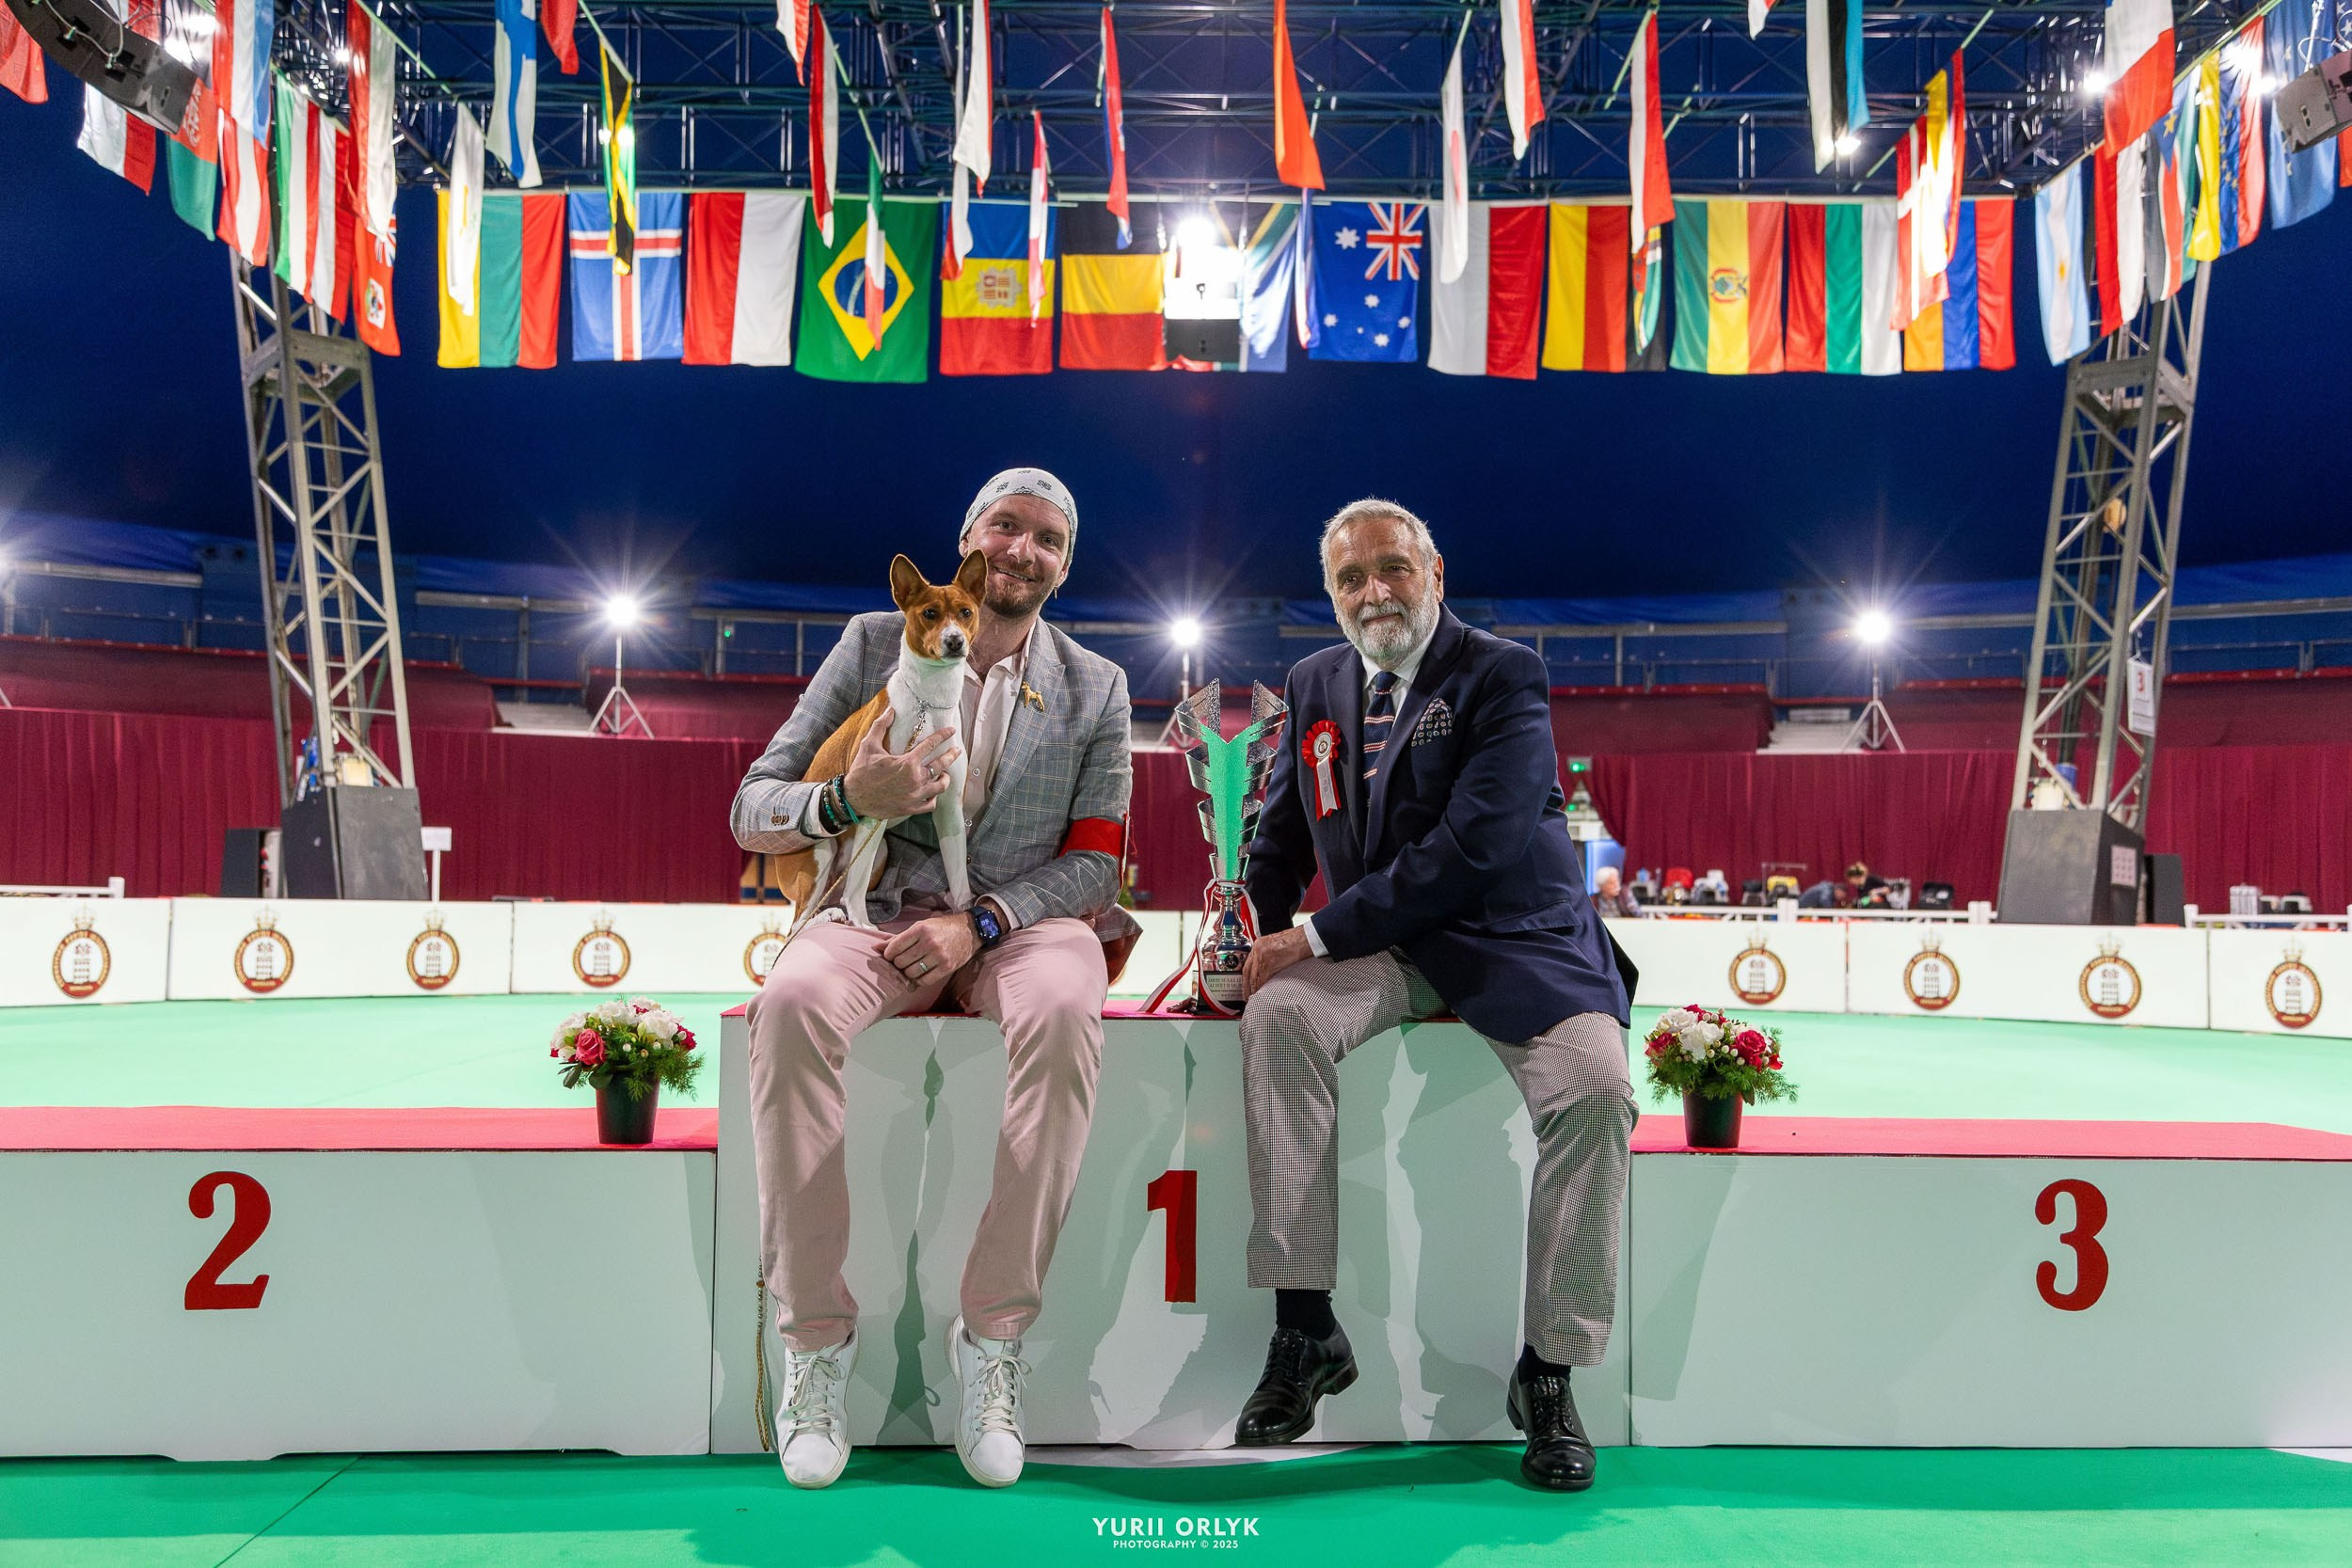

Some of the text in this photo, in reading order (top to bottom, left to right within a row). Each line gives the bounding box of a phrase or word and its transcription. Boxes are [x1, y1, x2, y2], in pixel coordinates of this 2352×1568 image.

[184, 1171, 271, 1310] 2
[1147, 1169, 1197, 1303] 1
[2035, 1179, 2108, 1311] 3
